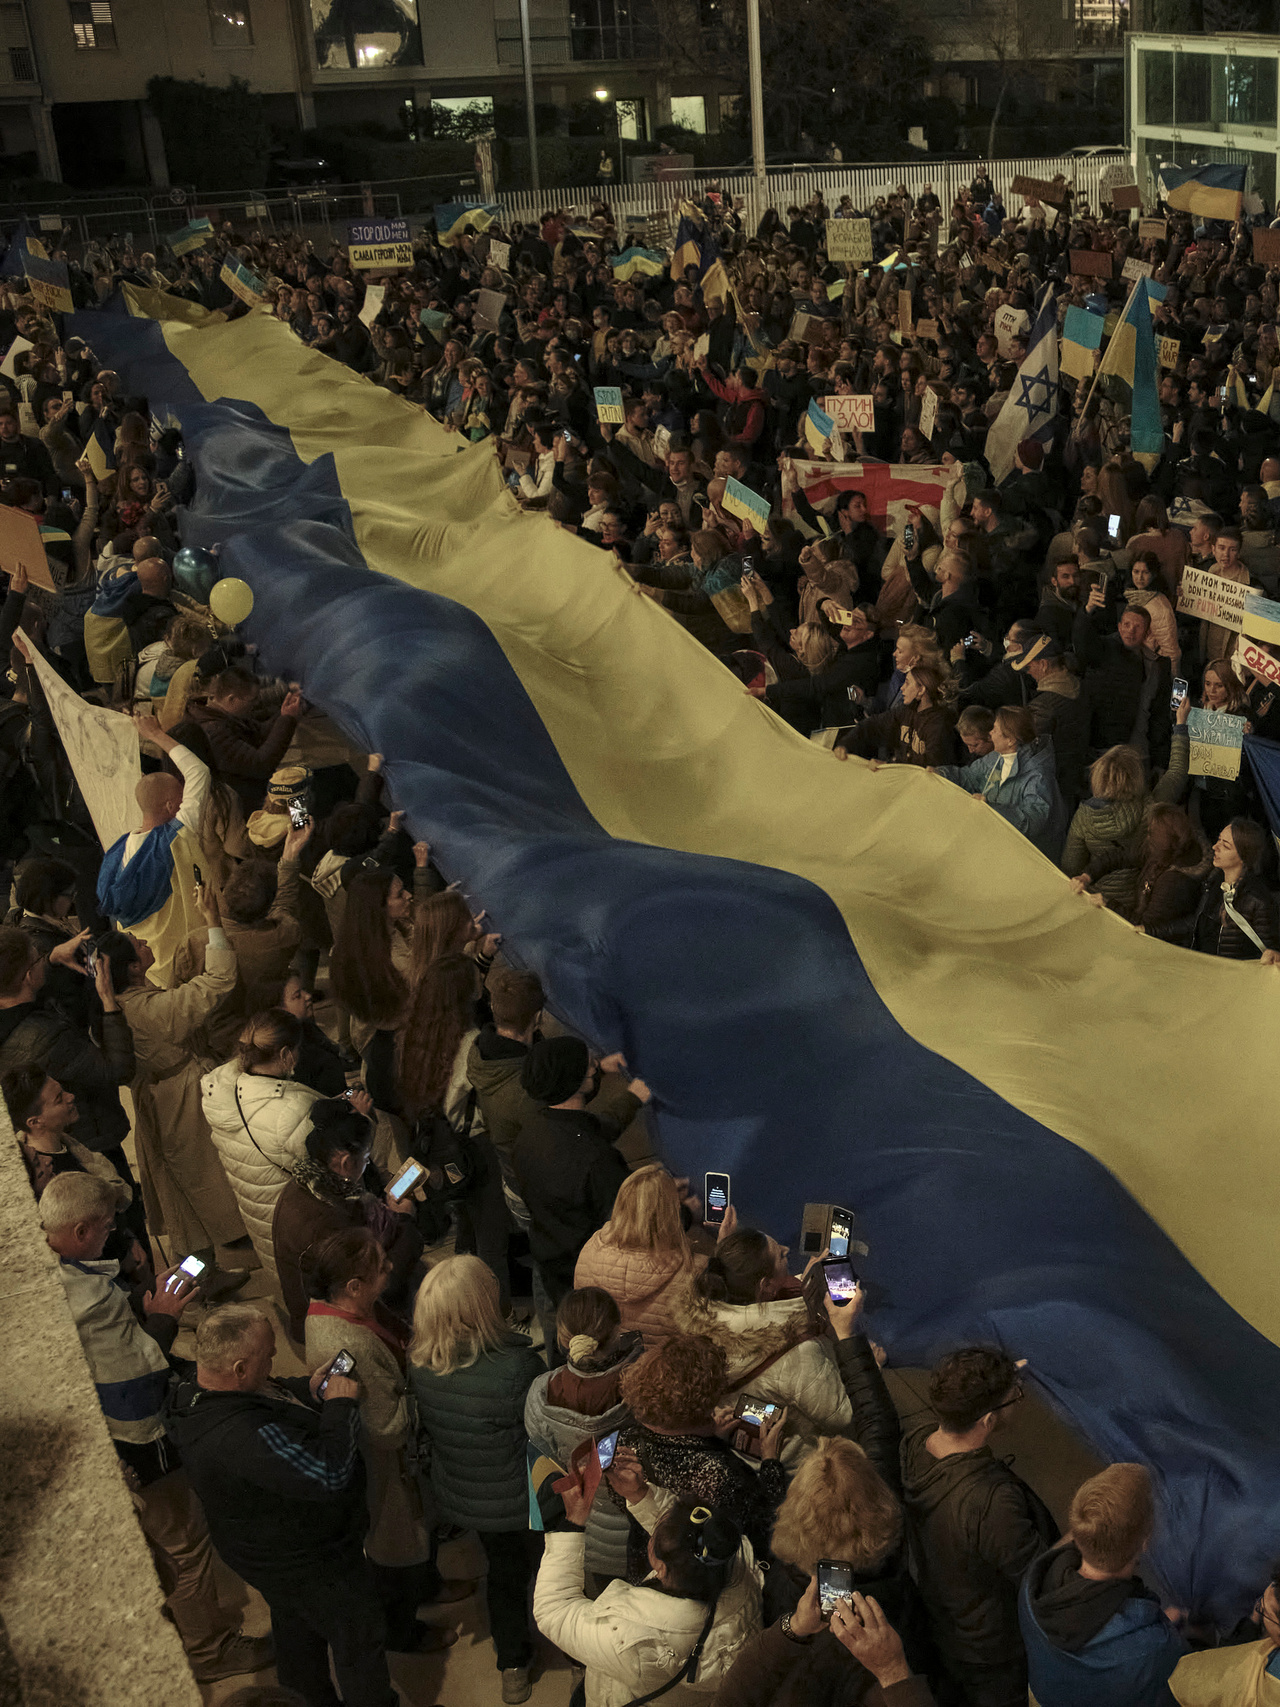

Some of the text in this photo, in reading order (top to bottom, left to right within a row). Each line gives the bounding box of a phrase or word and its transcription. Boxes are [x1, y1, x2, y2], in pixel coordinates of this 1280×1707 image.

[352, 225, 391, 241] STOP OLD
[827, 398, 872, 413] ПУТИН
[837, 412, 873, 430] ЗЛО!
[1185, 570, 1199, 582] MY
[1201, 575, 1218, 589] MOM
[1221, 582, 1237, 594] TOLD
[1188, 585, 1207, 597] DON'T
[1180, 598, 1194, 608] BUT
